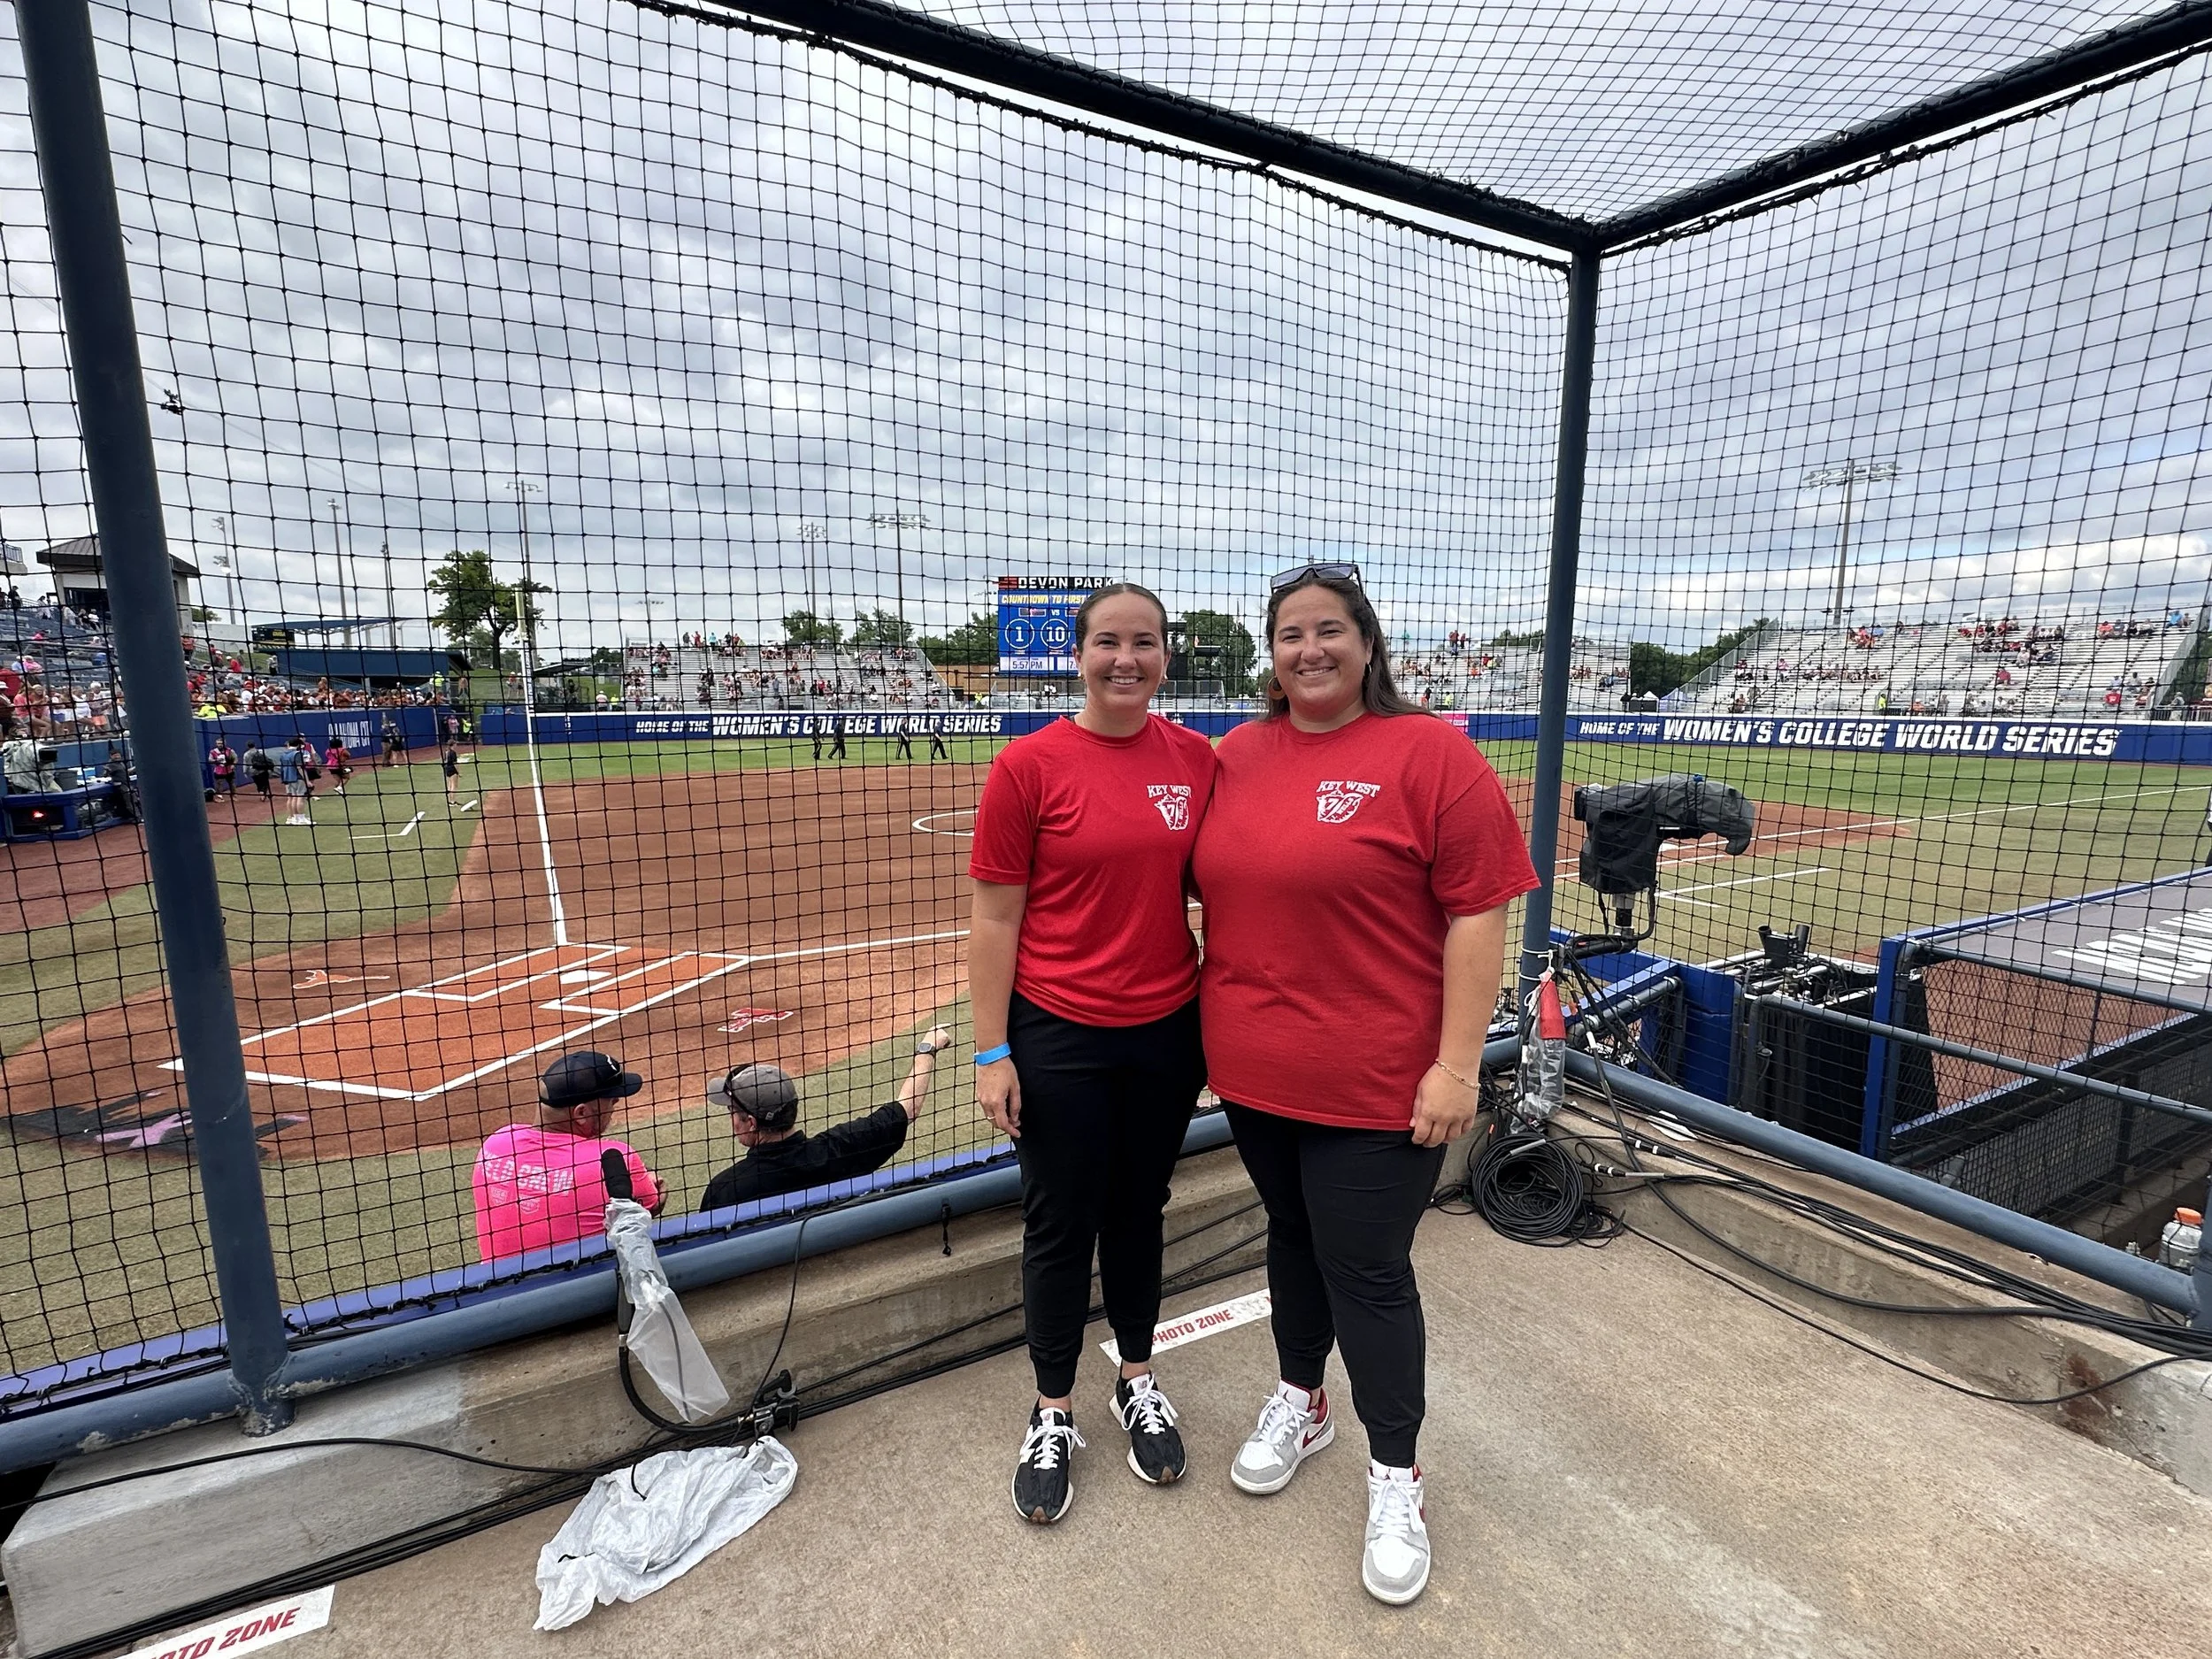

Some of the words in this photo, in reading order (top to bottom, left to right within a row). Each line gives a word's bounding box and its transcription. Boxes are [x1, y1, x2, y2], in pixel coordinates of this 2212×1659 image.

[1018, 577, 1068, 588] DEVON
[1074, 577, 1113, 588] PARK
[1052, 595, 1063, 604] TO
[1015, 626, 1024, 641] 1
[1046, 626, 1065, 641] 10
[635, 721, 670, 733] HOME
[672, 720, 684, 732] OF
[688, 720, 709, 732] THE
[712, 716, 800, 735] WOMEN'S
[803, 715, 878, 734] COLEGE
[942, 715, 1002, 733] SERIES
[1580, 721, 1616, 734] HOME
[1617, 722, 1634, 735] OF
[1637, 723, 1660, 735] THE
[1663, 718, 1775, 742] WOMEN'S
[1778, 721, 1890, 747] COLLEGE
[1894, 723, 2000, 751] WORLD
[2002, 725, 2120, 756] SERIES
[1147, 785, 1168, 798] KEY
[1317, 780, 1345, 793] KEY
[1346, 780, 1381, 797] WEST
[1152, 1322, 1195, 1345] PHOTO
[1195, 1310, 1233, 1329] ZONE
[218, 1607, 301, 1651] ZONE
